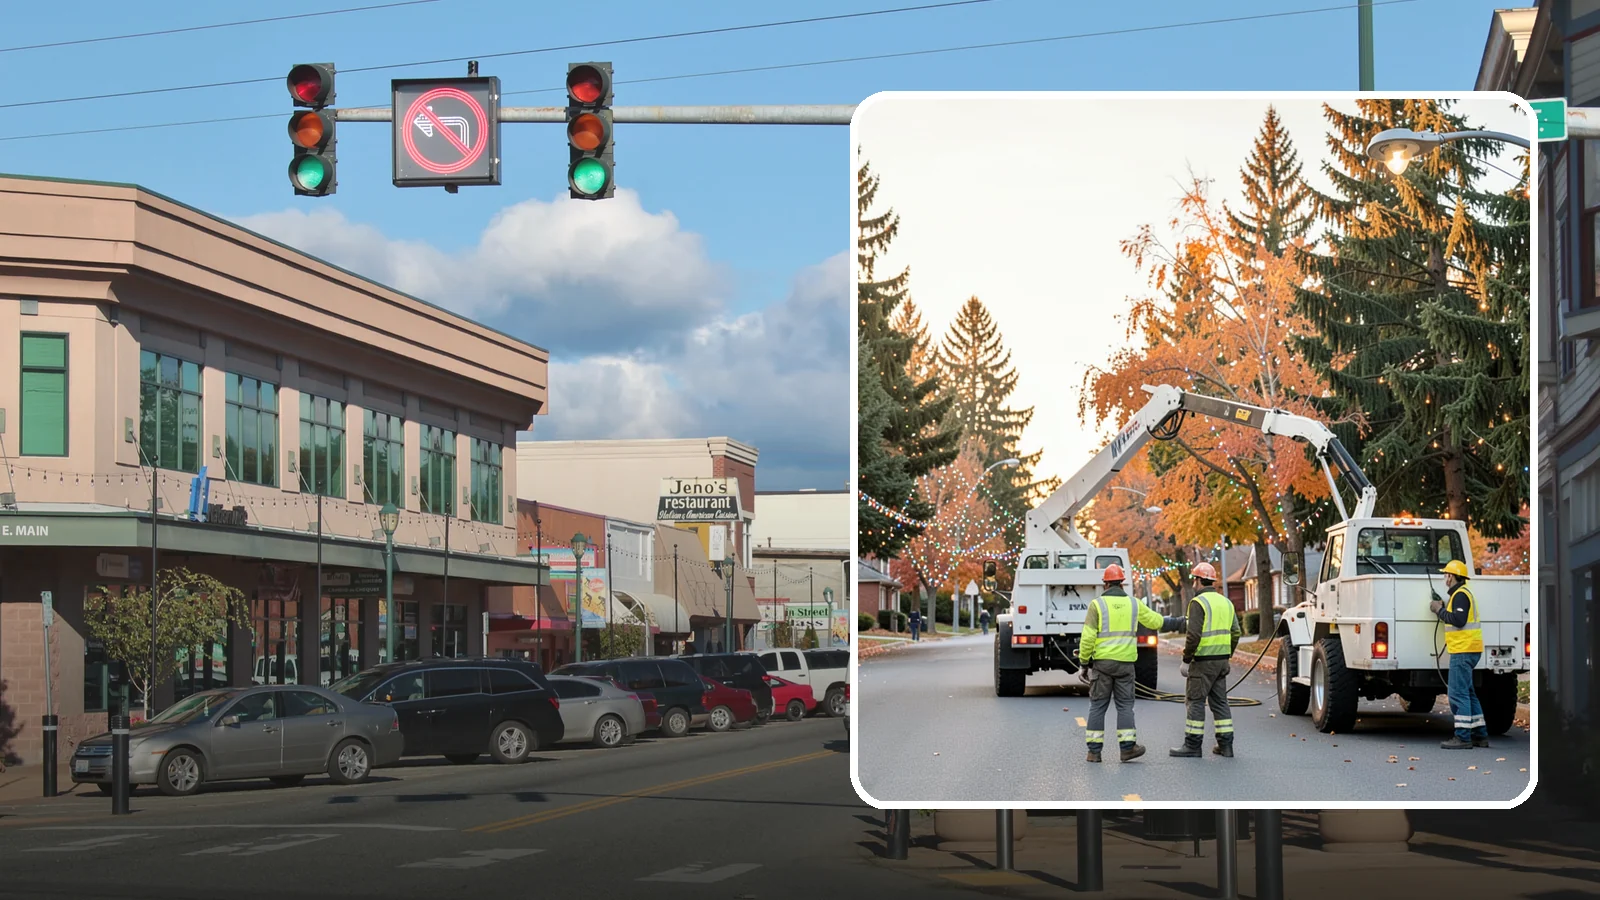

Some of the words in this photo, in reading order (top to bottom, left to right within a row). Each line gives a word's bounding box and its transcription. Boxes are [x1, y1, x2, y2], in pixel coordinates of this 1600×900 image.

[669, 480, 727, 494] Jeno's
[665, 496, 731, 509] restaurant
[658, 510, 681, 519] Italian
[686, 510, 714, 519] American
[715, 509, 737, 519] Cuisine
[2, 525, 13, 536] E.
[15, 525, 49, 536] MAIN
[797, 608, 828, 616] Street
